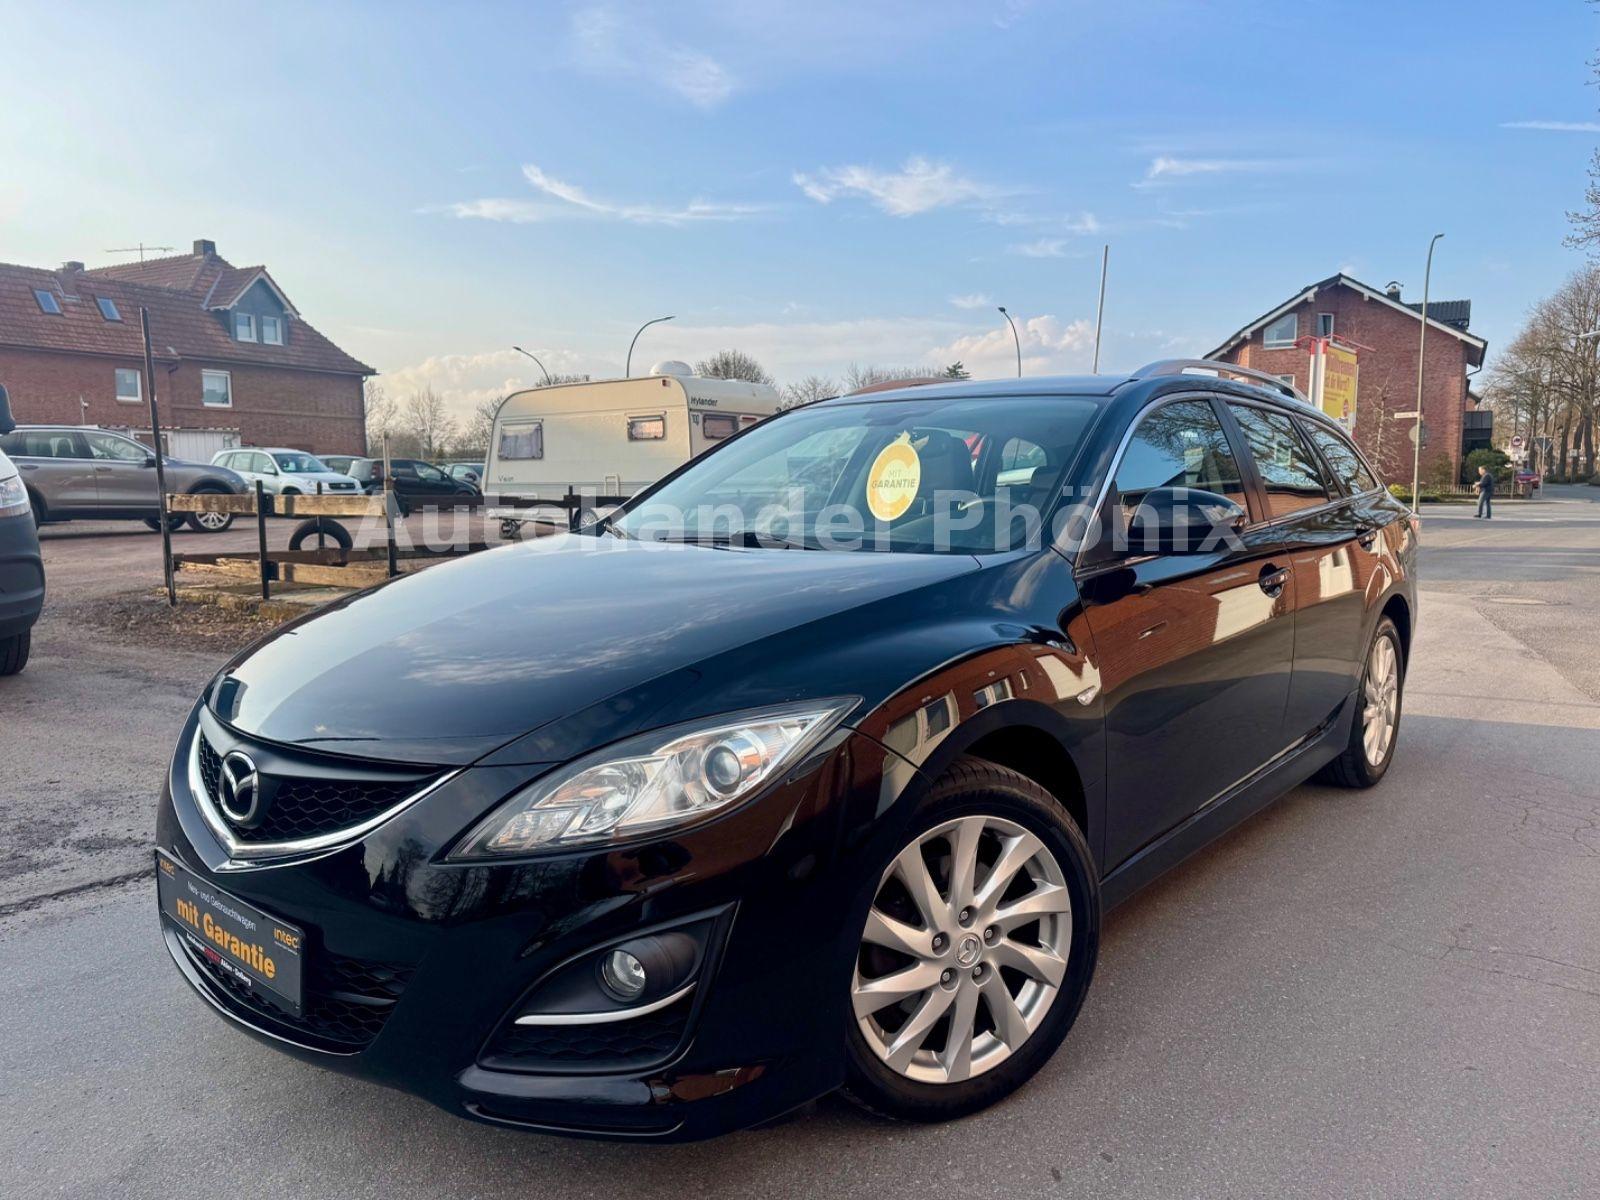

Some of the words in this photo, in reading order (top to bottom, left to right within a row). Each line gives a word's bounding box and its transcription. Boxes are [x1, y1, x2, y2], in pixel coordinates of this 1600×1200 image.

[888, 469, 902, 478] MIT
[872, 479, 916, 489] GARANTIE
[176, 896, 199, 928] mit
[203, 913, 276, 979] Garantie
[274, 928, 299, 949] intec
